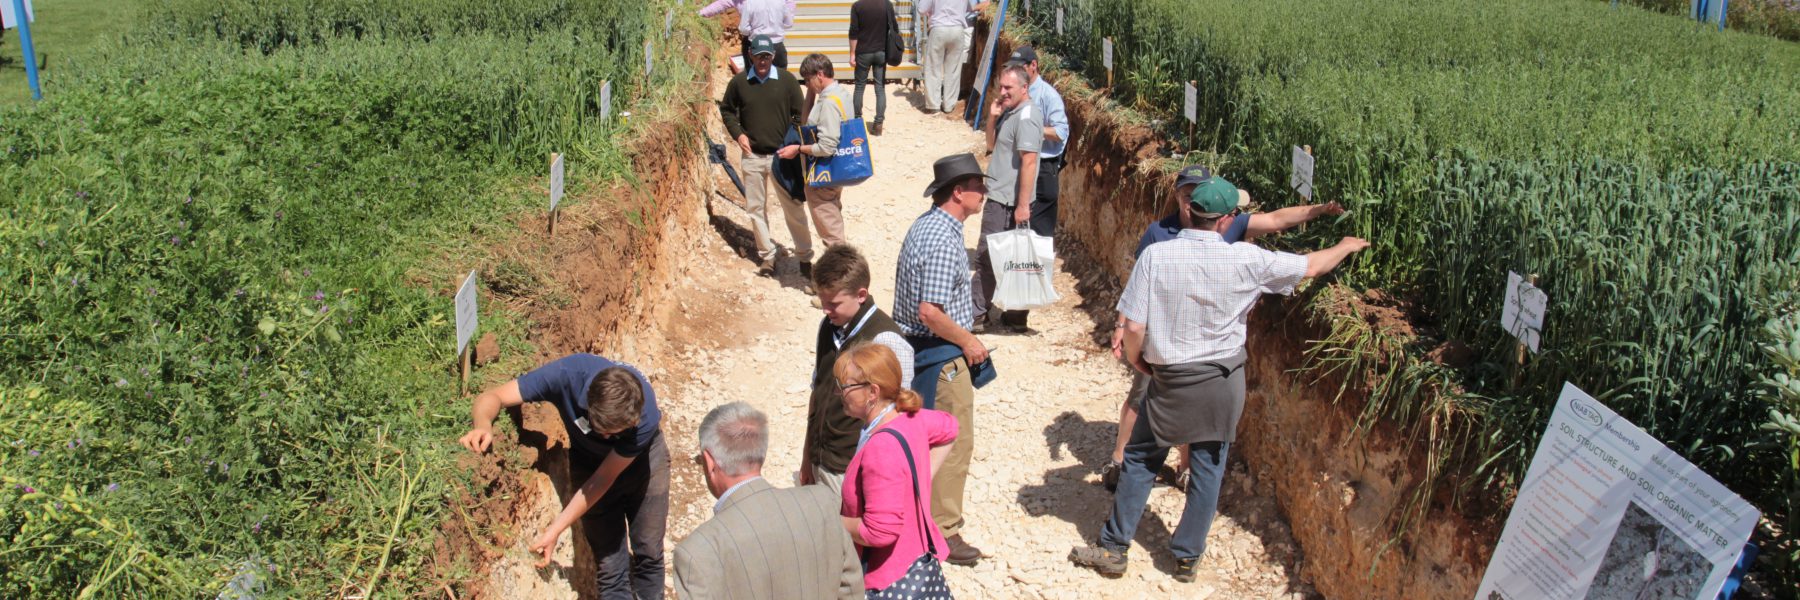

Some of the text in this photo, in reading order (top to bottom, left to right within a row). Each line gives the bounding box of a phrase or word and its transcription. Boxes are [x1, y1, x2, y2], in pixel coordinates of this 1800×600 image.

[1604, 422, 1640, 452] Membership
[1560, 422, 1576, 440] SOIL
[1575, 434, 1619, 469] STRUCTURE
[1618, 464, 1638, 482] AND
[1637, 477, 1656, 497] SOIL
[1655, 491, 1697, 525] ORGANIC
[1694, 519, 1729, 550] MATTER
[1651, 454, 1741, 524] Make us part of your agronomy
